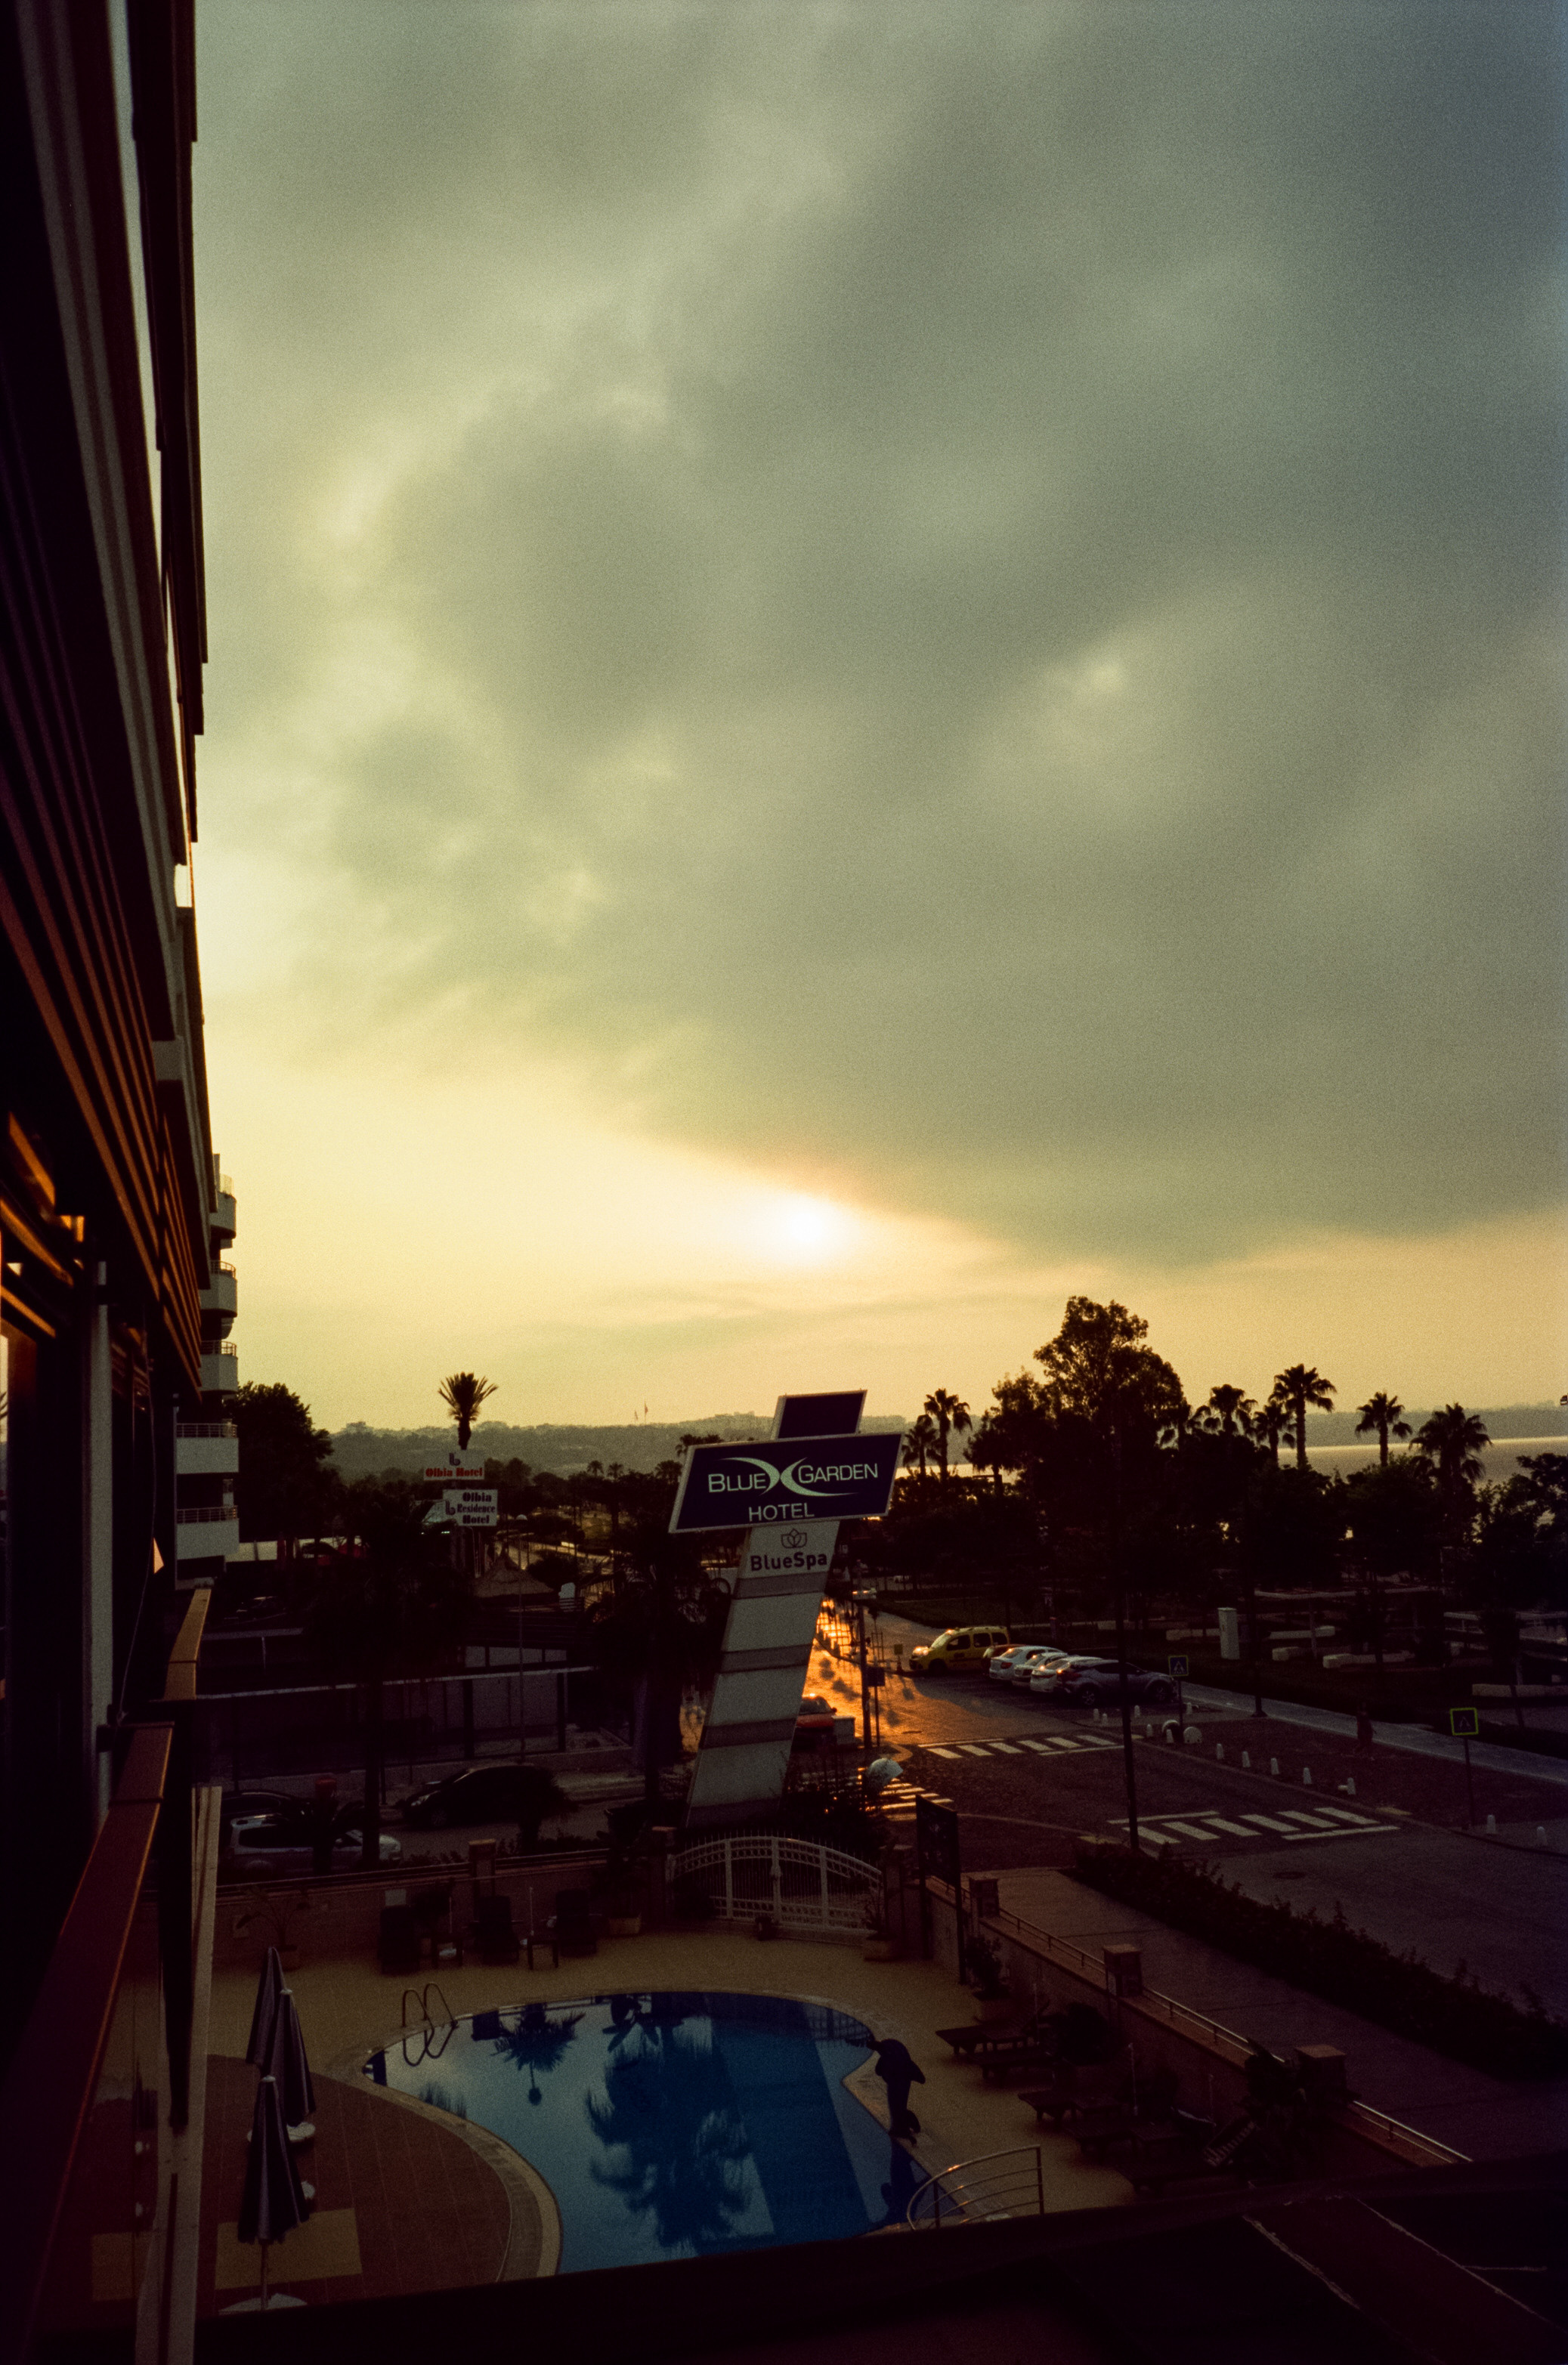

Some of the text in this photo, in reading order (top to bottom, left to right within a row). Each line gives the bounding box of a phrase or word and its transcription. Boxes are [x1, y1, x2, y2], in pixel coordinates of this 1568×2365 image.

[425, 1467, 482, 1476] Olbia Hotel
[708, 1463, 879, 1493] BLUE GARDEN
[462, 1492, 491, 1502] Olbia
[457, 1504, 496, 1513] Residence
[748, 1502, 815, 1523] HOTEL
[462, 1515, 489, 1523] Hotel
[750, 1552, 827, 1571] BlueSpa
